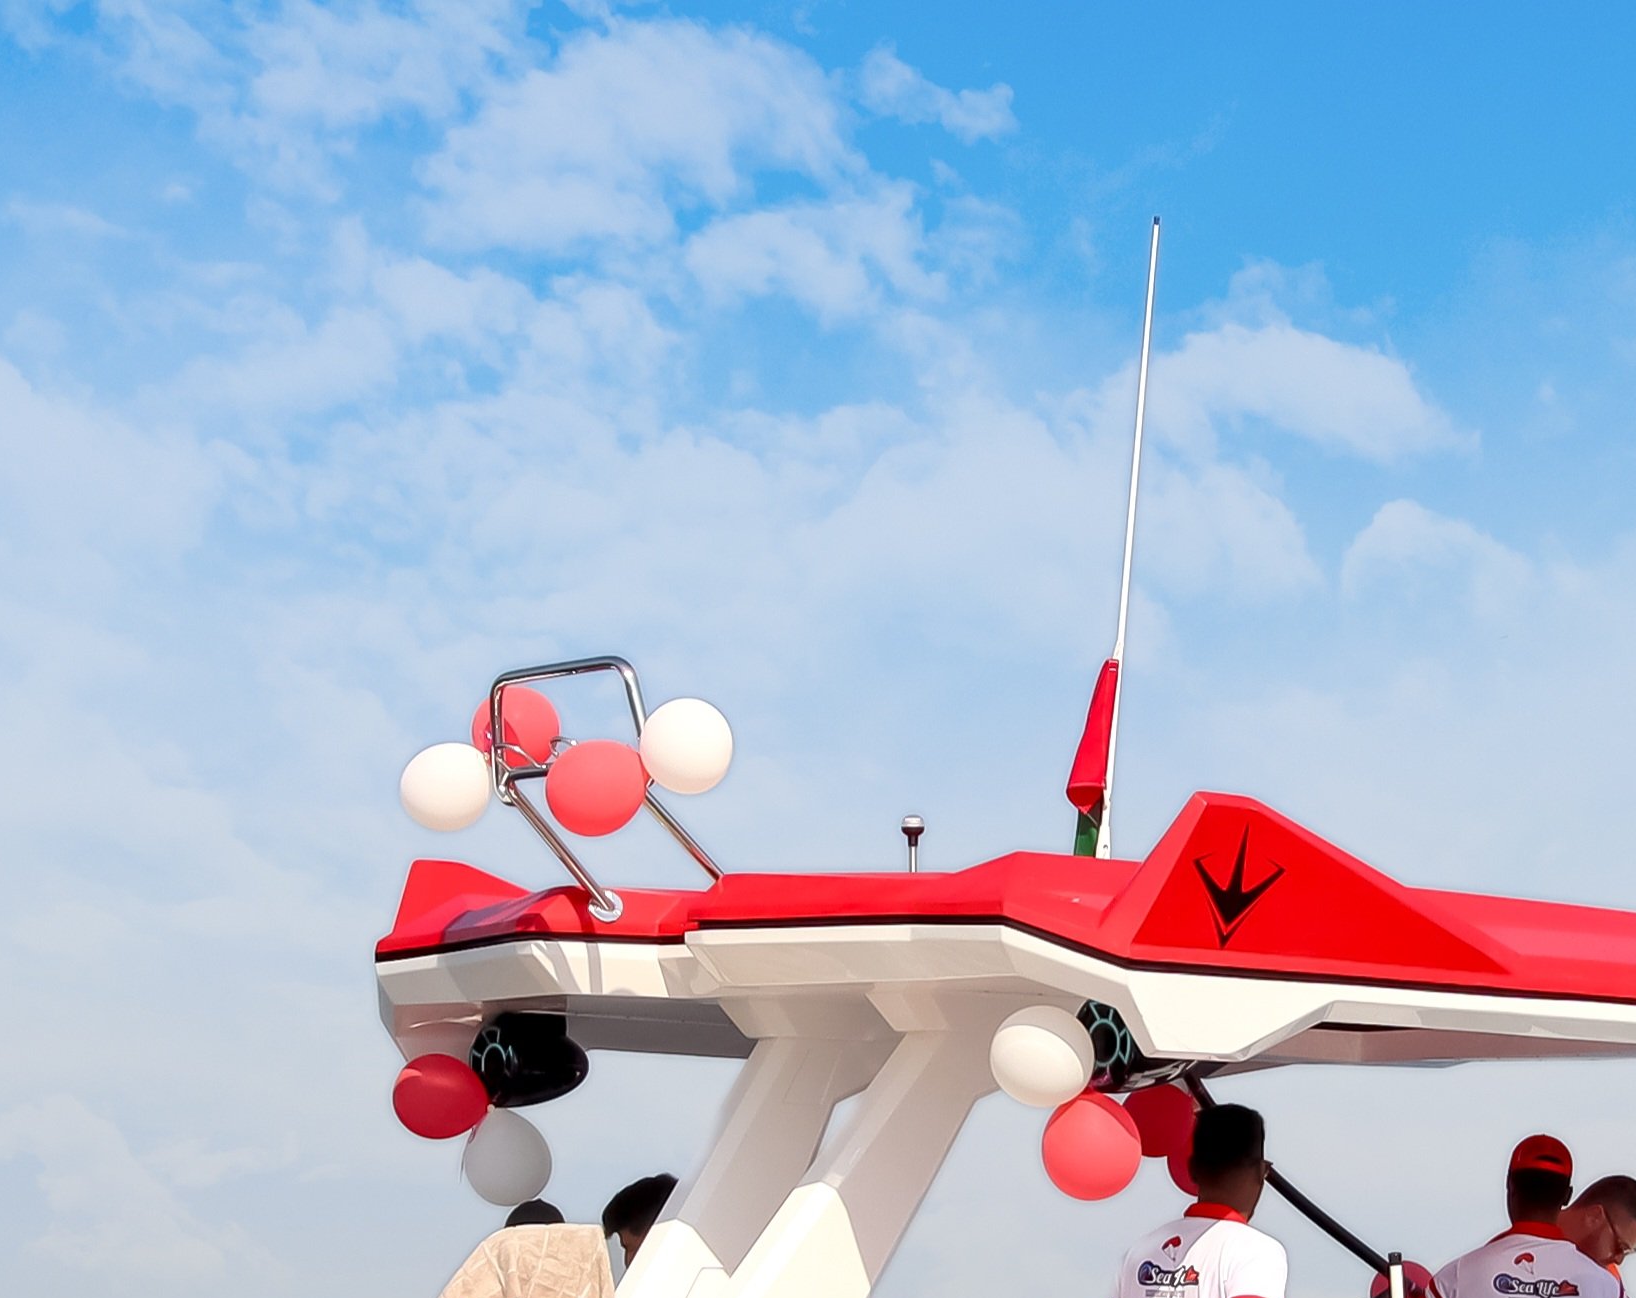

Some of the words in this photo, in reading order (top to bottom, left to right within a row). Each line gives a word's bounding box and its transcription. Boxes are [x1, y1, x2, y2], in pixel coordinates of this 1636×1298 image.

[1145, 1266, 1172, 1284] Sea
[1508, 1280, 1534, 1293] Sea
[1536, 1281, 1560, 1298] Life
